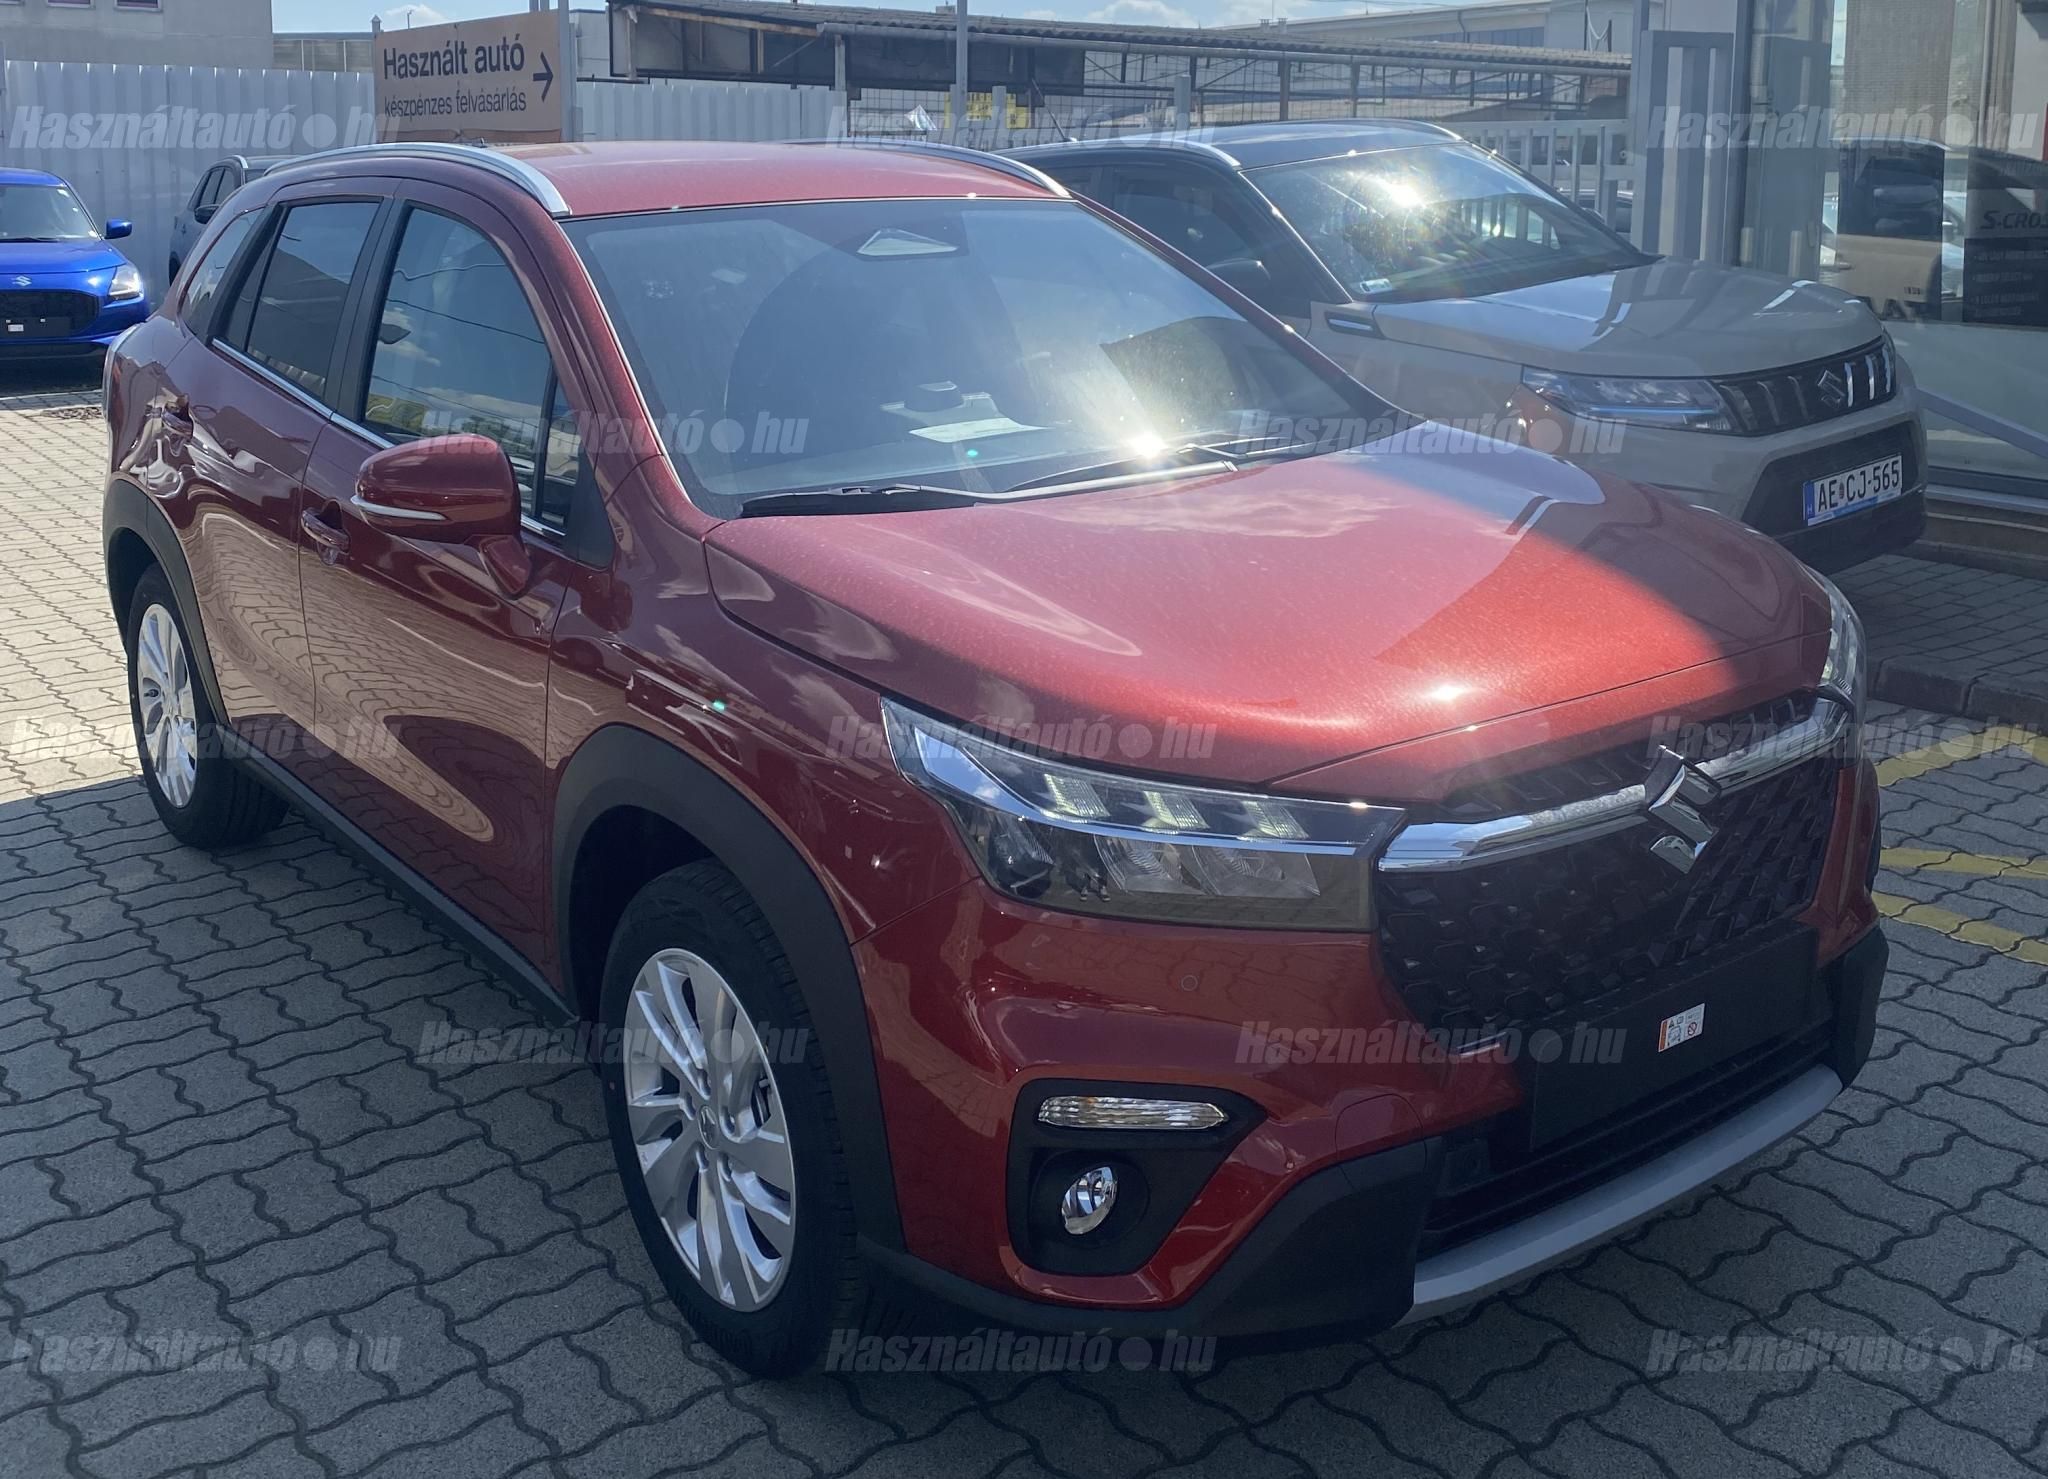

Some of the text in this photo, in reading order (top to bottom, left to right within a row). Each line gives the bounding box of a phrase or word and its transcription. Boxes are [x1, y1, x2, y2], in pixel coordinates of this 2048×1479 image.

[383, 33, 525, 80] Használt autó
[384, 87, 527, 122] készpénzes felvásárlás
[1818, 480, 1838, 512] AE
